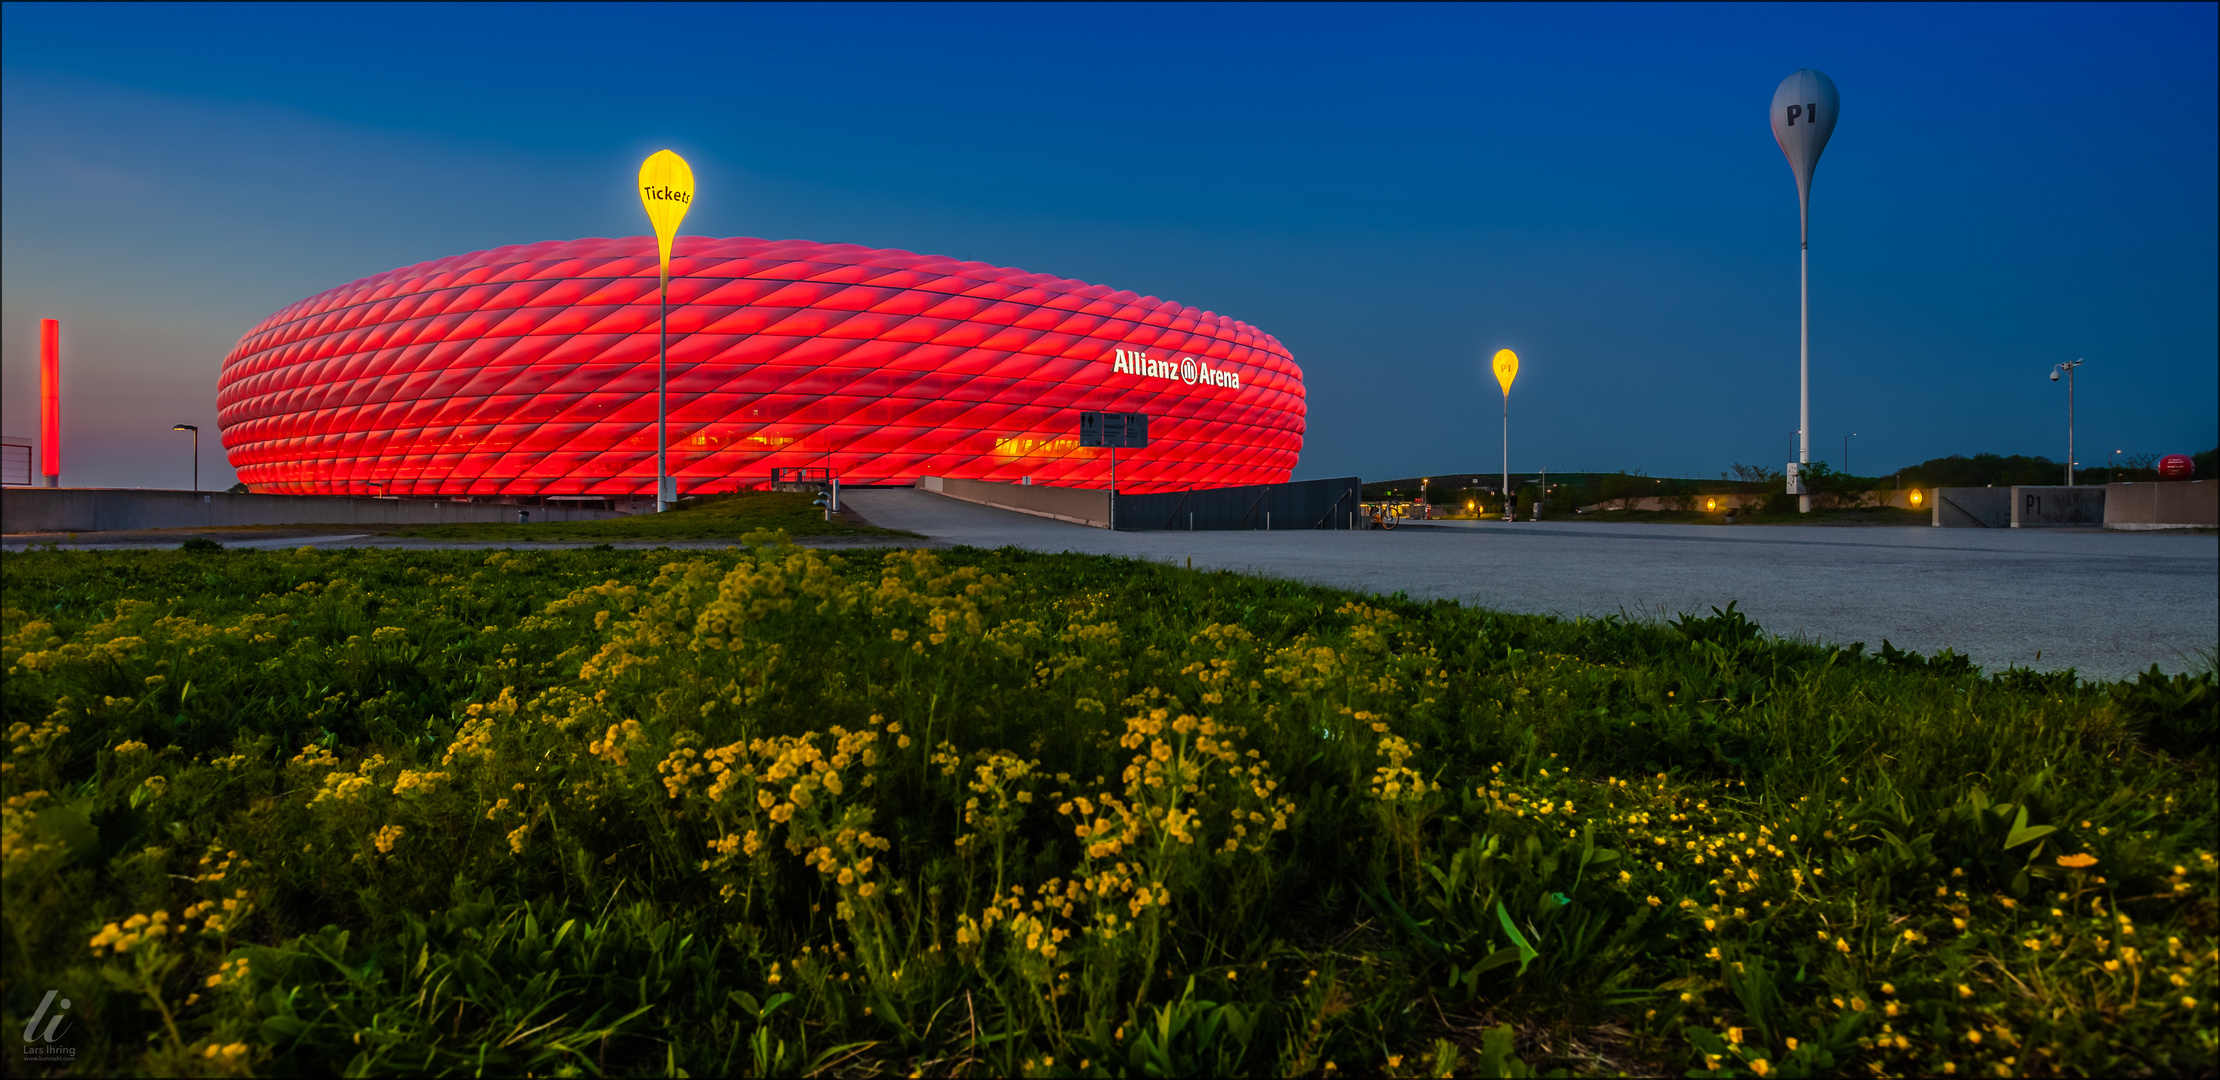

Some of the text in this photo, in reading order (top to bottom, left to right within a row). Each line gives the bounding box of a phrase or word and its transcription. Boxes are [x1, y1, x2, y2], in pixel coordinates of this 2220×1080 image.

[1787, 103, 1816, 126] P1
[644, 186, 690, 204] Tickets
[1113, 349, 1239, 389] Allianz Arena
[2026, 494, 2040, 515] P1
